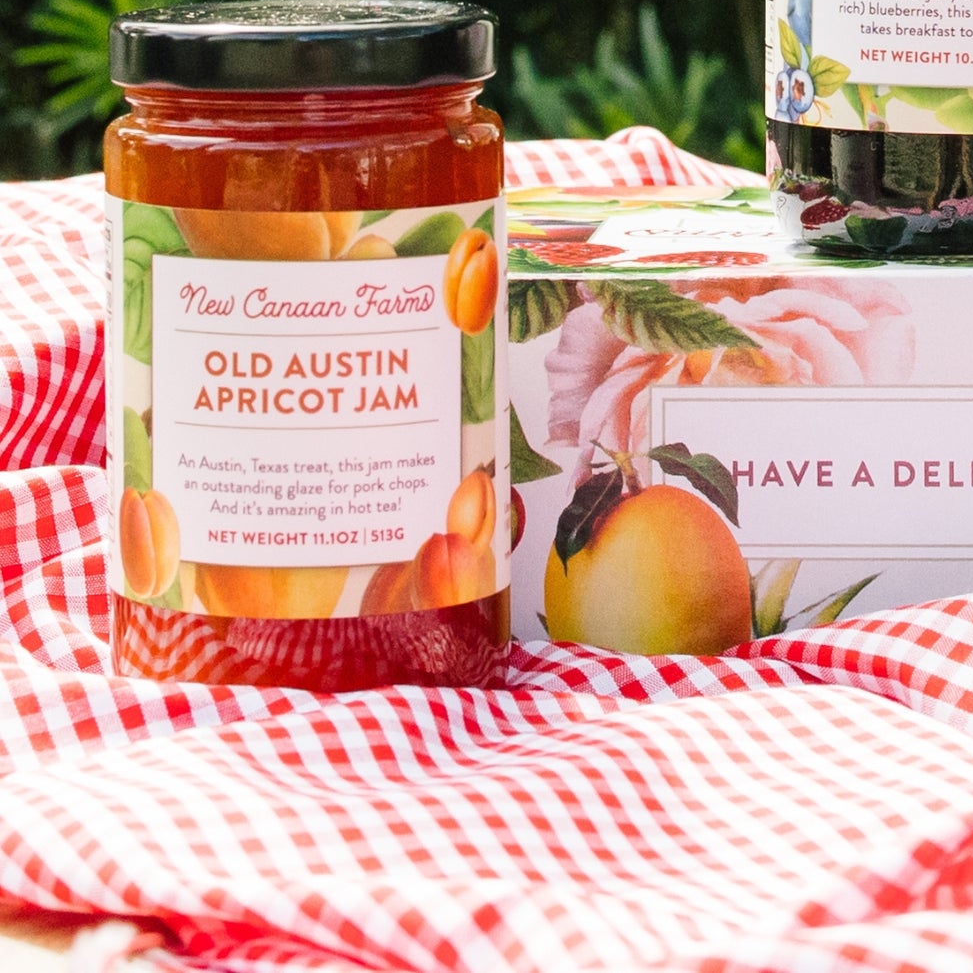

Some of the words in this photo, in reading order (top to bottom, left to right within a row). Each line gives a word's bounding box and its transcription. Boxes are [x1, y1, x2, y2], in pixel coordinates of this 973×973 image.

[838, 0, 866, 16] rich)
[868, 1, 943, 20] blueberries,
[947, 4, 972, 19] this
[860, 21, 892, 36] takes
[895, 22, 956, 38] breakfast
[959, 27, 973, 38] to
[860, 49, 888, 62] NET
[891, 50, 952, 64] WEIGHT
[179, 282, 235, 317] New
[242, 287, 347, 319] Canaan
[353, 282, 436, 318] Farms
[204, 350, 273, 379] OLD
[283, 348, 409, 379] AUSTIN
[193, 386, 345, 415] APRICOT
[353, 383, 419, 413] JAM
[177, 452, 196, 469] An
[198, 455, 247, 476] Austin,
[251, 457, 289, 474] Texas
[293, 461, 334, 475] treat,
[338, 455, 365, 473] this
[364, 456, 393, 477] jam
[396, 452, 436, 468] makes
[731, 460, 834, 488] HAVE
[851, 460, 875, 488] A
[183, 479, 199, 490] an
[201, 478, 284, 501] outstanding
[286, 480, 324, 501] glaze
[327, 478, 350, 495] for
[353, 476, 385, 498] pork
[388, 475, 430, 494] chops.
[209, 498, 239, 515] And
[266, 500, 327, 522] amazing
[330, 500, 344, 516] in
[347, 500, 372, 515] hot
[376, 496, 402, 513] tea!
[208, 530, 238, 544] NET
[241, 531, 309, 546] WEIGHT
[312, 530, 359, 545] 11.1OZ
[370, 527, 405, 543] 513G
